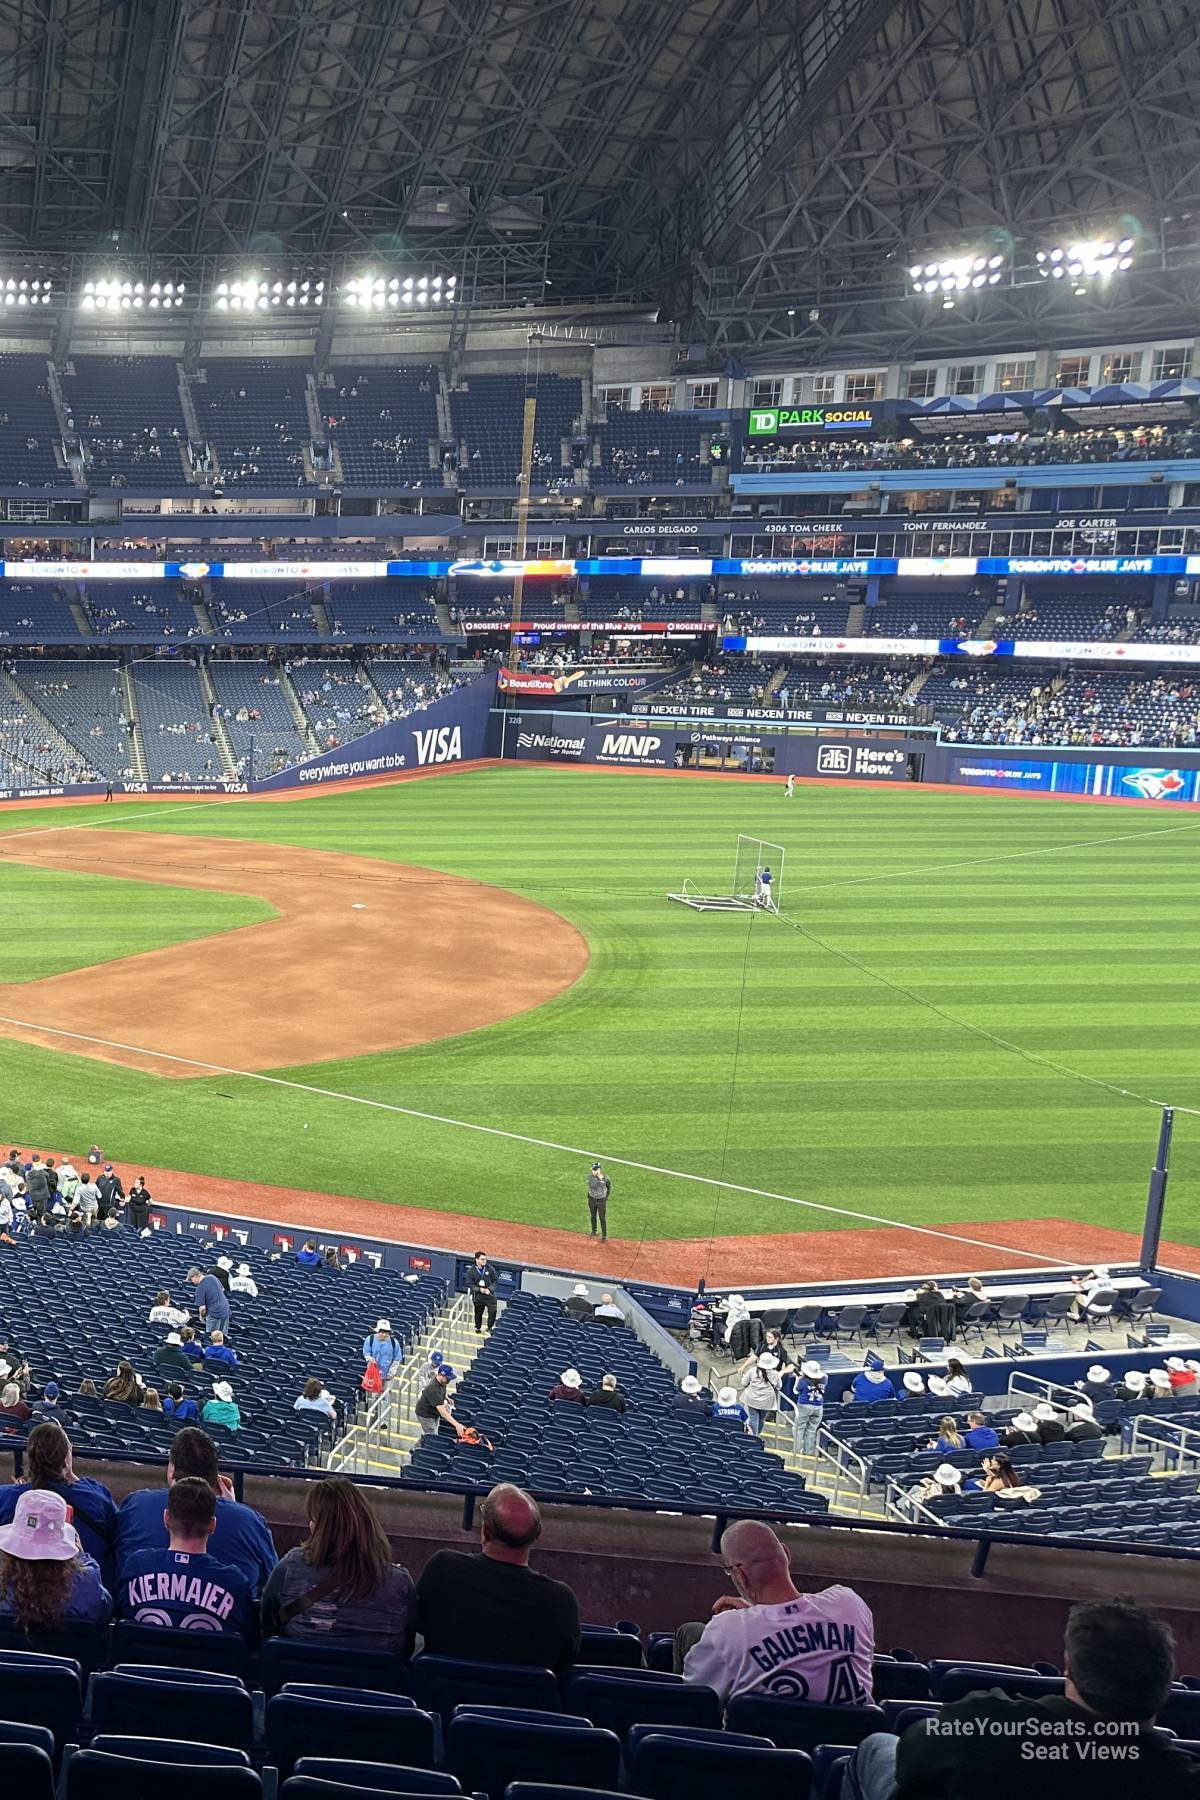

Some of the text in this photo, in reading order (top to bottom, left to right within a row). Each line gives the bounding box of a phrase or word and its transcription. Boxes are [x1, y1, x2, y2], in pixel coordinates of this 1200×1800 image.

[752, 410, 873, 430] TD PARK SOCIAL
[902, 521, 987, 531] TONY FERNANDEZ
[1056, 518, 1117, 528] JOE CARTER
[623, 525, 698, 534] CARLOS DELGADO
[764, 524, 843, 533] 4306 TOM CHEEK
[741, 562, 868, 574] TORONTO BLUE JAYS
[1008, 559, 1153, 573] TORONTO BLUE JAYS
[533, 622, 556, 630] Proud
[581, 622, 590, 630] of
[590, 622, 604, 630] the
[604, 622, 623, 630] Blue
[623, 622, 642, 632] Jays
[676, 623, 703, 631] ROGERS
[509, 679, 553, 689] BeautiTone
[577, 678, 647, 688] RETHINK COLOUR
[651, 705, 687, 714] NEXEN
[689, 706, 715, 716] TIRE
[747, 708, 785, 719] NEXEN
[787, 710, 813, 720] TIRE
[846, 713, 885, 724] NEXEN
[701, 734, 761, 743] Pathways Alliance
[412, 726, 463, 765] VISA
[602, 734, 661, 756] MNP
[561, 748, 582, 756] Rental
[855, 748, 904, 762] Here's
[595, 754, 619, 762] Wherever
[299, 753, 405, 781] everywhere you want to be
[855, 760, 893, 775] How.
[960, 767, 1042, 780] TORONTO BLUE JAYS
[19, 787, 64, 797] BASELINE BOX
[122, 782, 148, 792] VISA
[222, 782, 248, 792] VISA
[0, 790, 13, 799] BET
[128, 1572, 235, 1620] KIERMAIER
[749, 1622, 856, 1673] GAUSMAN
